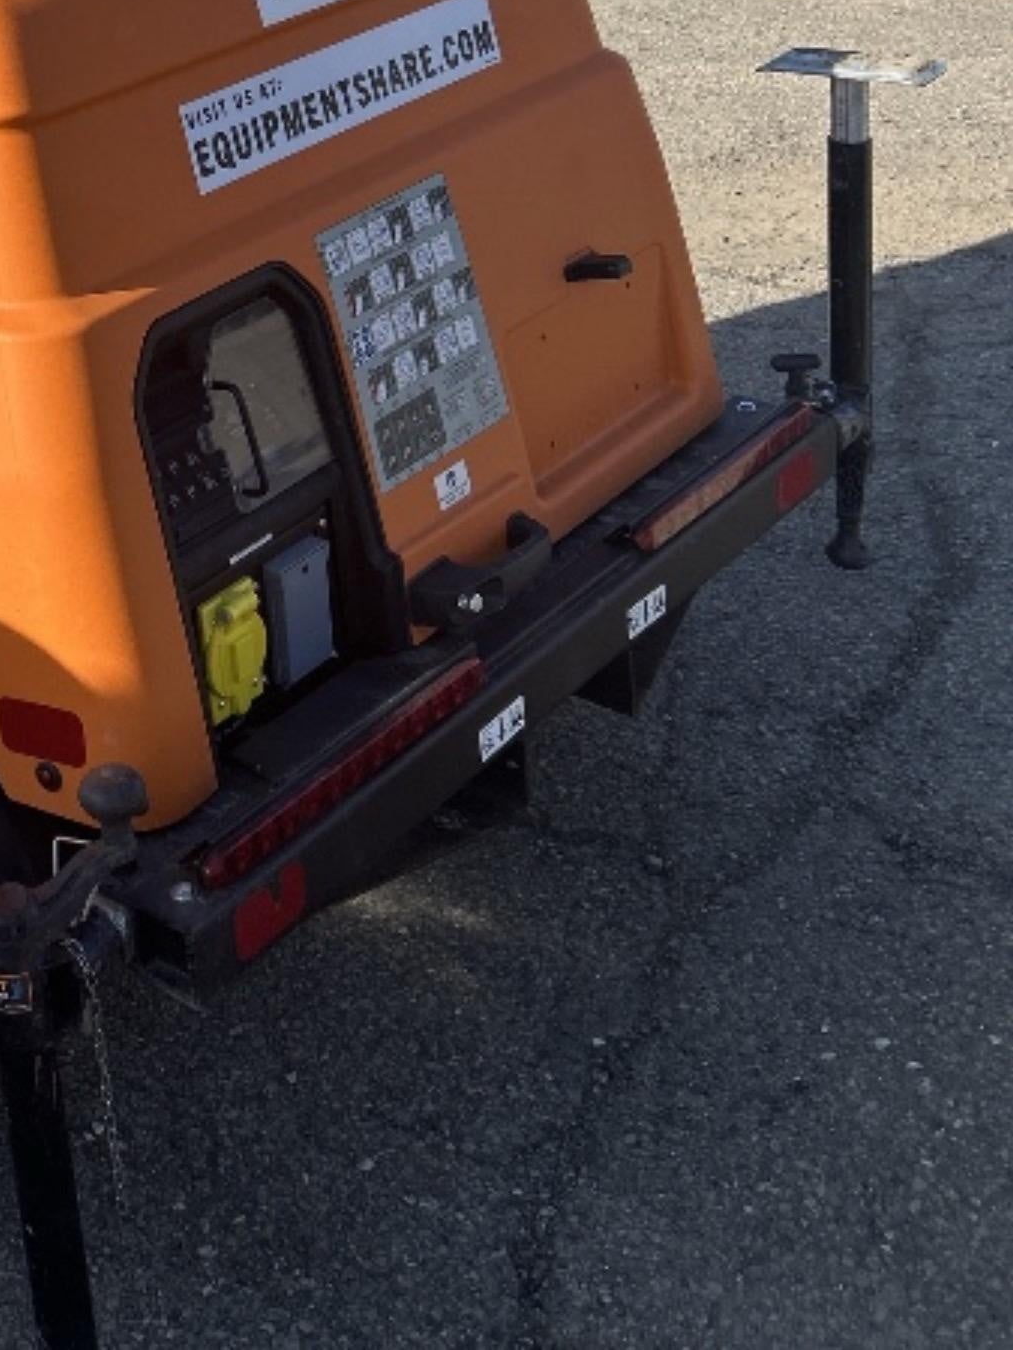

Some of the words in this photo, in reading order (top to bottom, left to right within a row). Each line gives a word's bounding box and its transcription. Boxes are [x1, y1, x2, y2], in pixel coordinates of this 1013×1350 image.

[185, 98, 228, 130] VISIT
[233, 89, 254, 110] US
[259, 77, 283, 99] AT:
[193, 20, 496, 178] EQUIPMENTSHARE.COM
